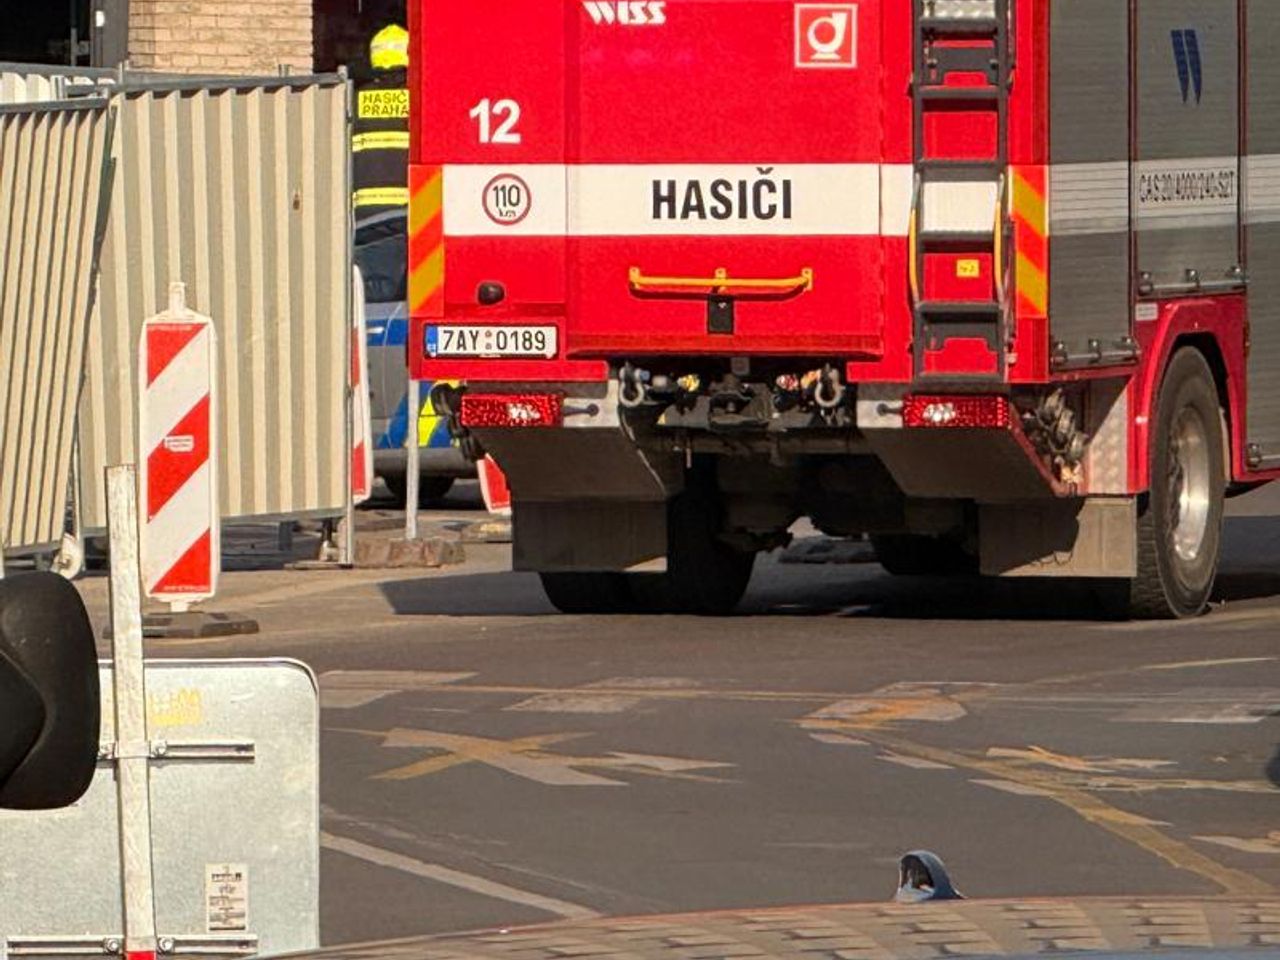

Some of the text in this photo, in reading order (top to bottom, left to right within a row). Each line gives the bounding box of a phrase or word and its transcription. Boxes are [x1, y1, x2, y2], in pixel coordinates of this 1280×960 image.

[582, 0, 667, 25] WISS
[362, 90, 408, 105] HASIČ
[362, 103, 409, 116] PRAHA
[468, 97, 522, 145] 12
[492, 183, 521, 208] 110
[652, 166, 792, 220] HASIČI
[443, 329, 547, 352] 7AY 0189
